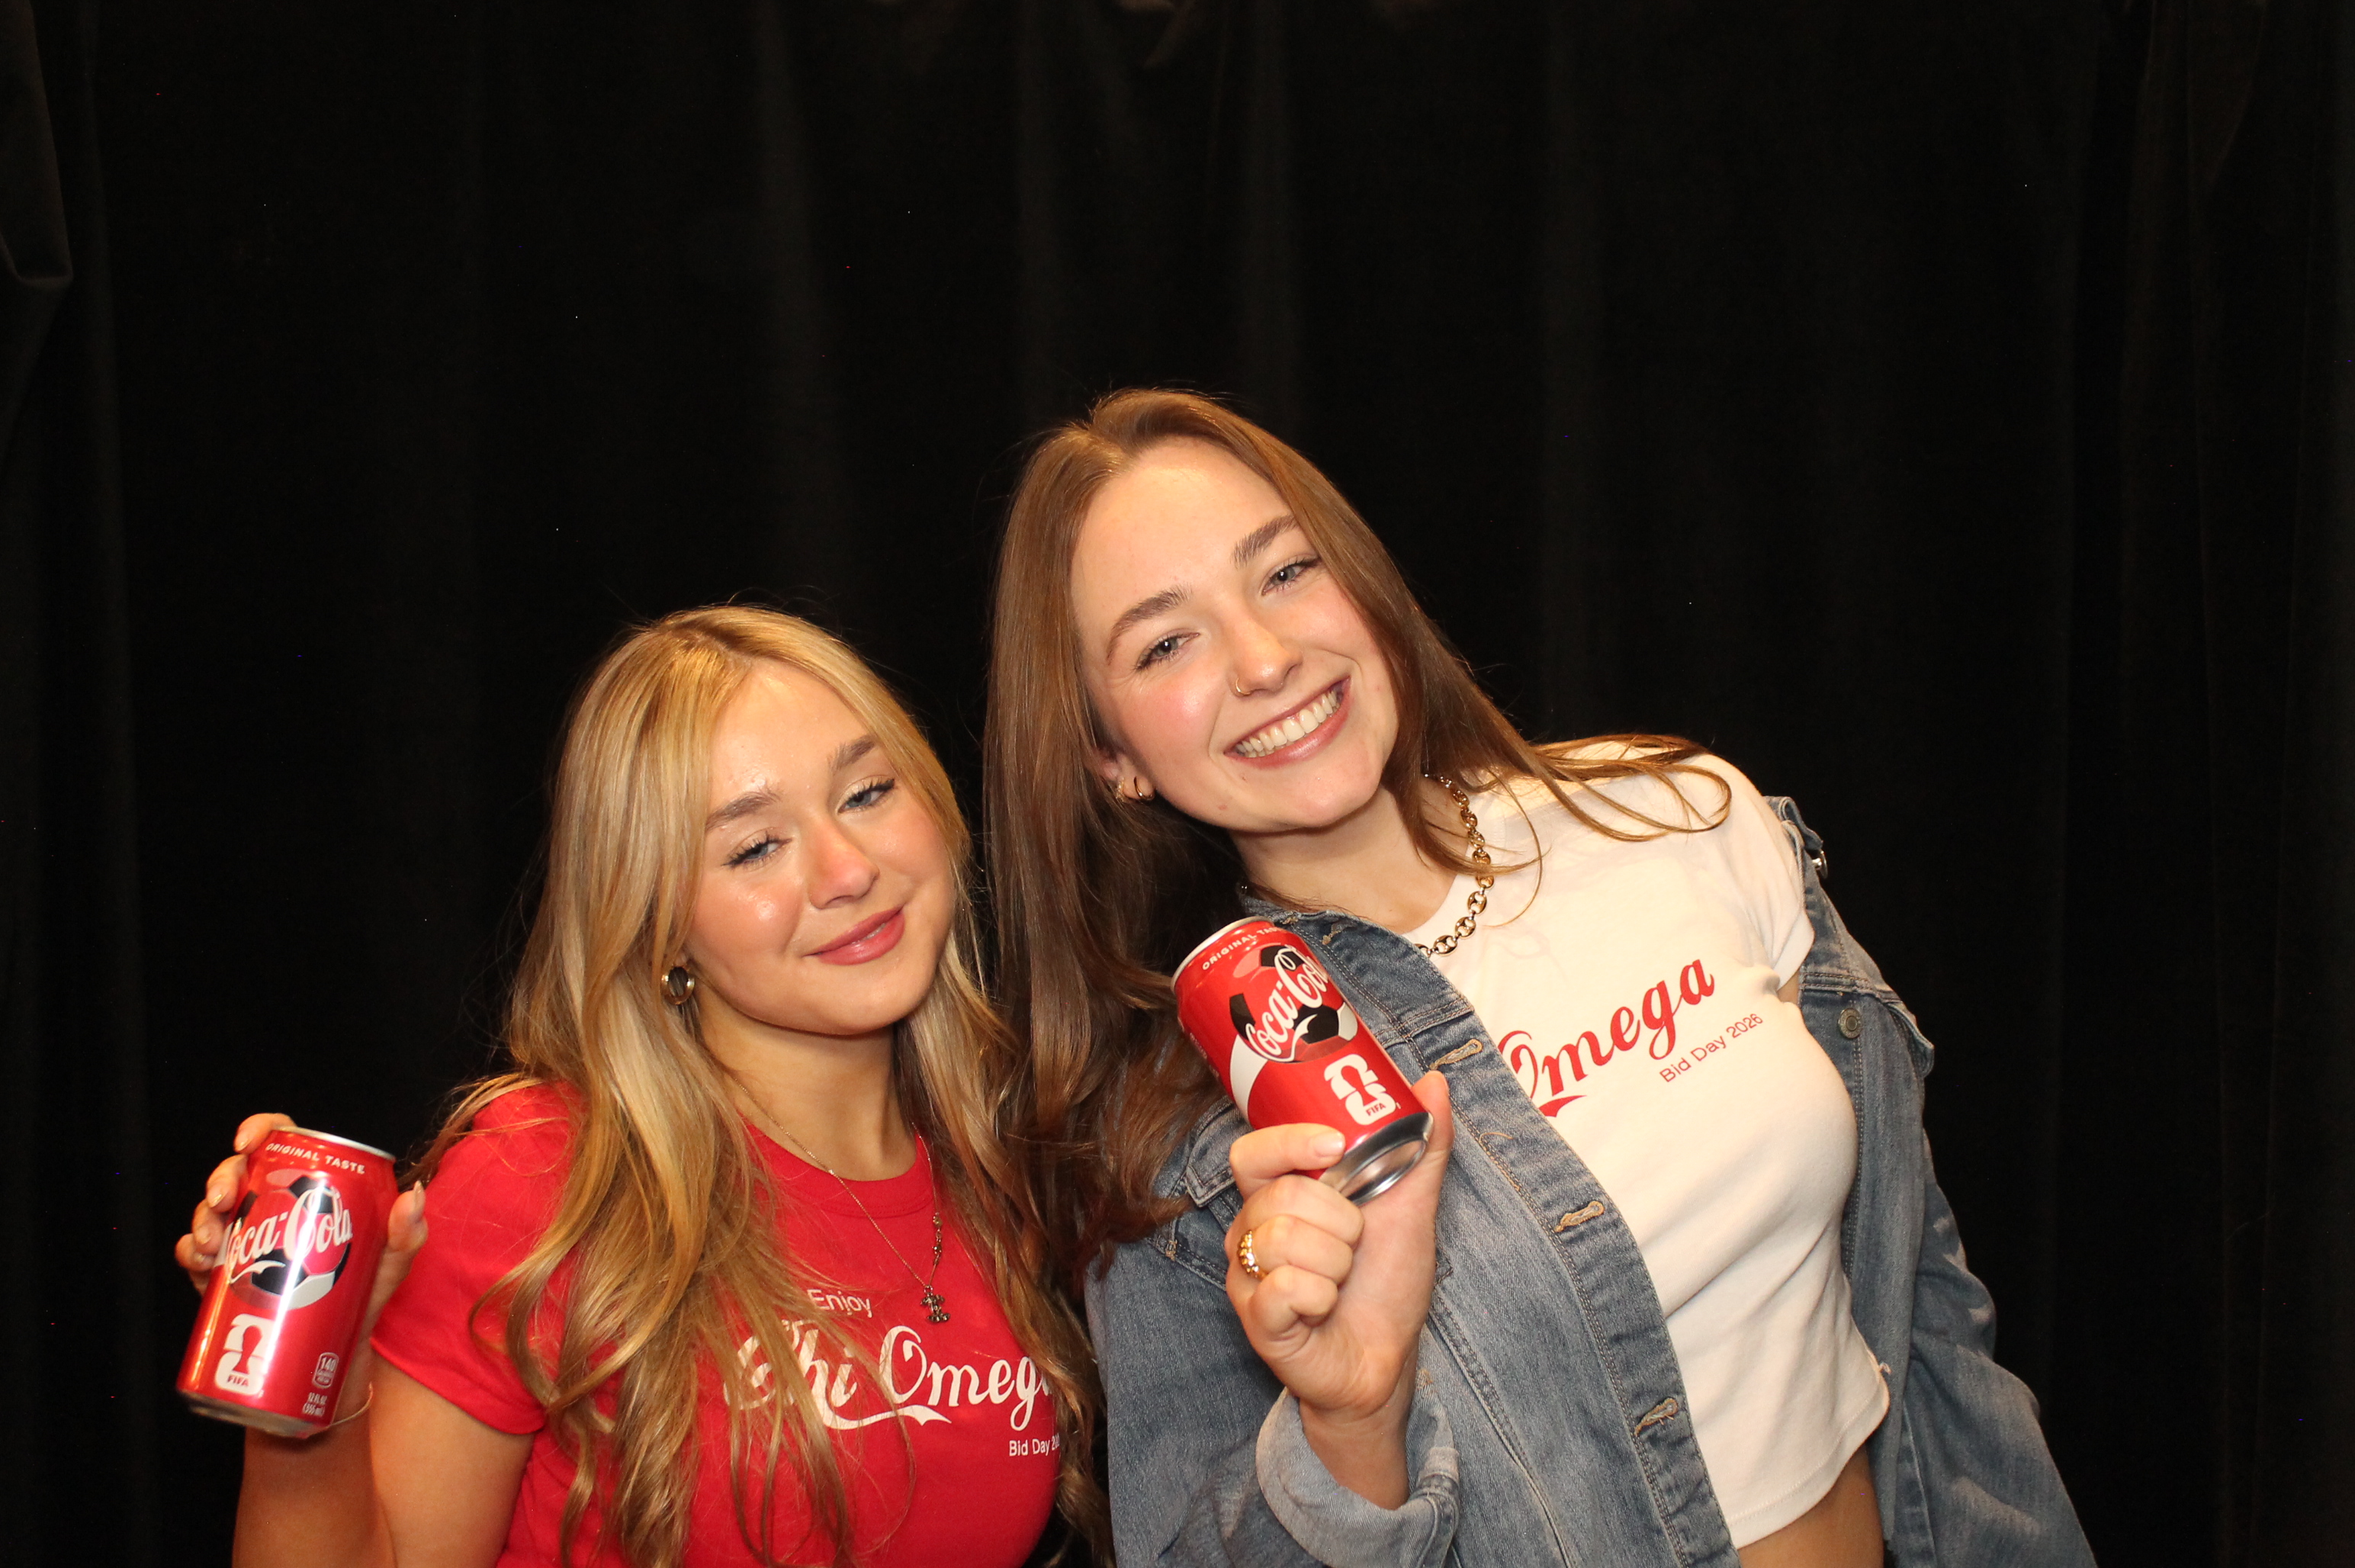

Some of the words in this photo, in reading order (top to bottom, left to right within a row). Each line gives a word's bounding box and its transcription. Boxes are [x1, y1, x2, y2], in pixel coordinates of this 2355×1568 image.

[1202, 934, 1257, 970] ORIGINAL
[1245, 944, 1329, 1062] Coca-Col
[1659, 1057, 1692, 1083] Bid
[1690, 1035, 1727, 1062] Day
[1726, 1013, 1763, 1039] 2026
[1365, 1102, 1386, 1117] FIFA
[265, 1142, 320, 1162] ORIGINAL
[325, 1154, 365, 1174] TASTE
[806, 1289, 872, 1318] Enjoy
[320, 1357, 336, 1372] 140
[879, 1325, 1049, 1431] Omeg
[227, 1375, 249, 1386] FIFA
[1009, 1439, 1029, 1457] Bid
[1032, 1438, 1051, 1457] Day
